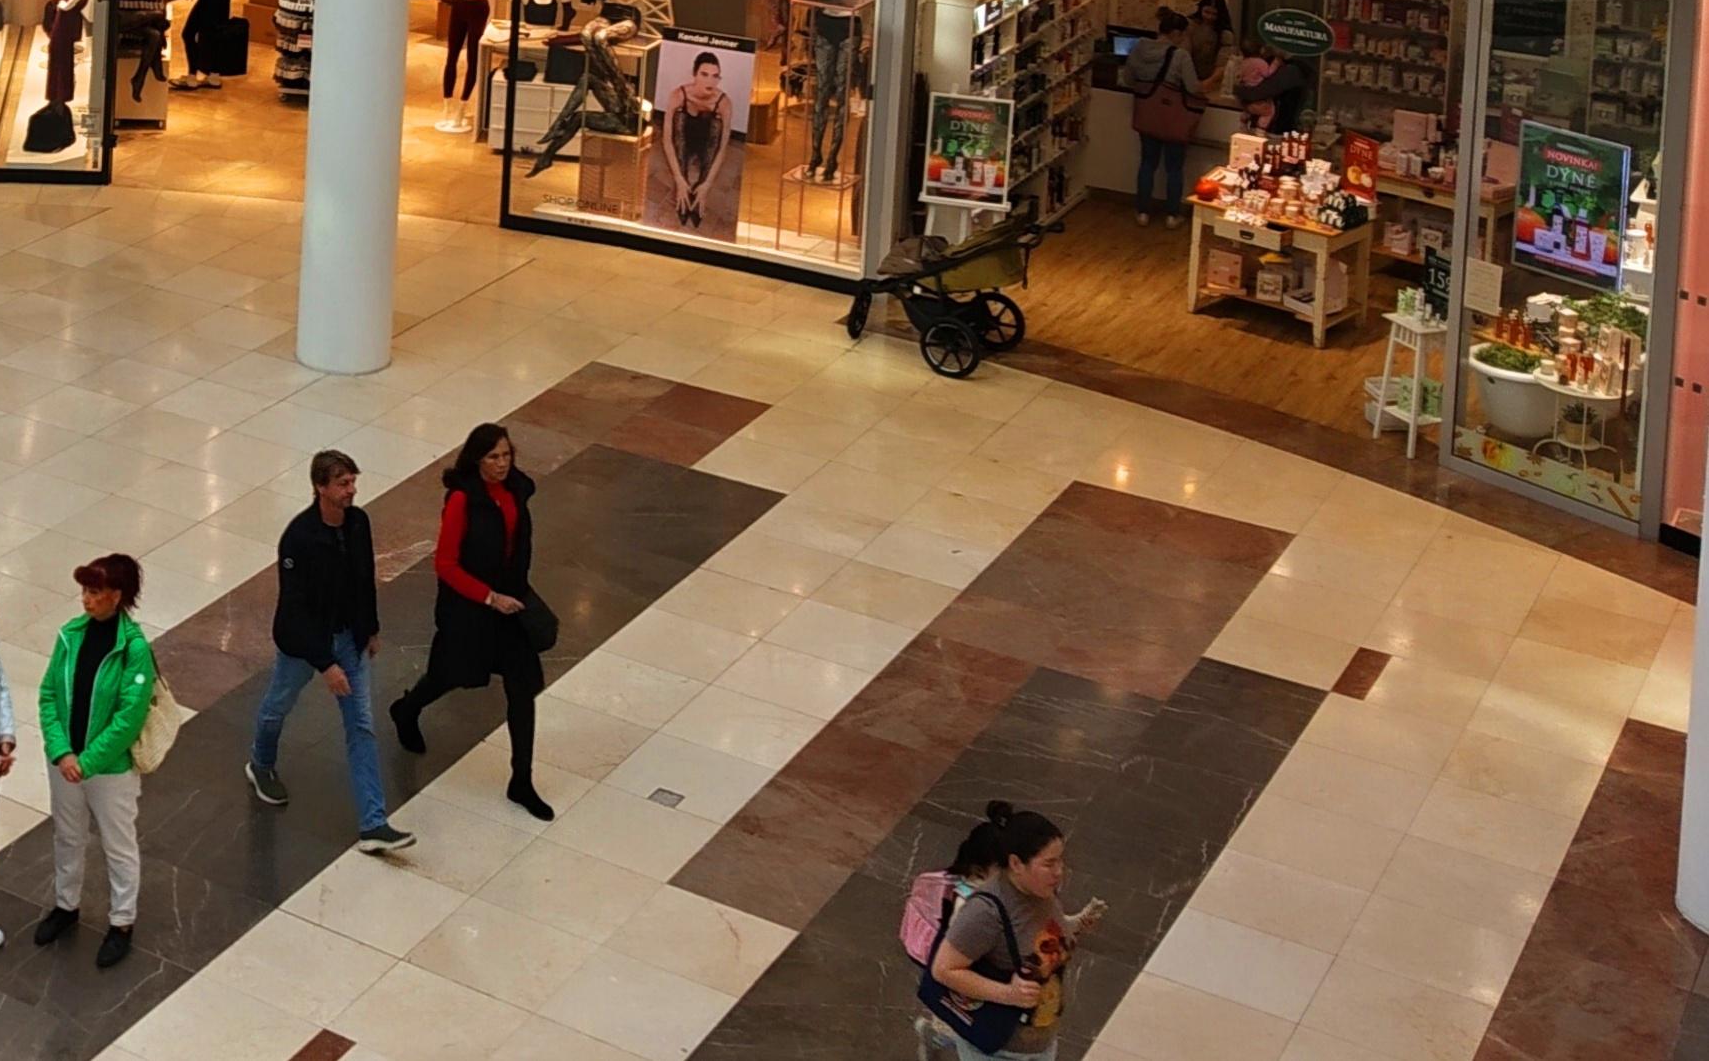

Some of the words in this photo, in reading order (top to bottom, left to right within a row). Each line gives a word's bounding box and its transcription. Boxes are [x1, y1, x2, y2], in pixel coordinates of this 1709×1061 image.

[677, 32, 708, 44] Kendall
[709, 37, 739, 48] Jenner
[1546, 149, 1598, 169] NOVINKA!
[542, 194, 574, 206] SHOP
